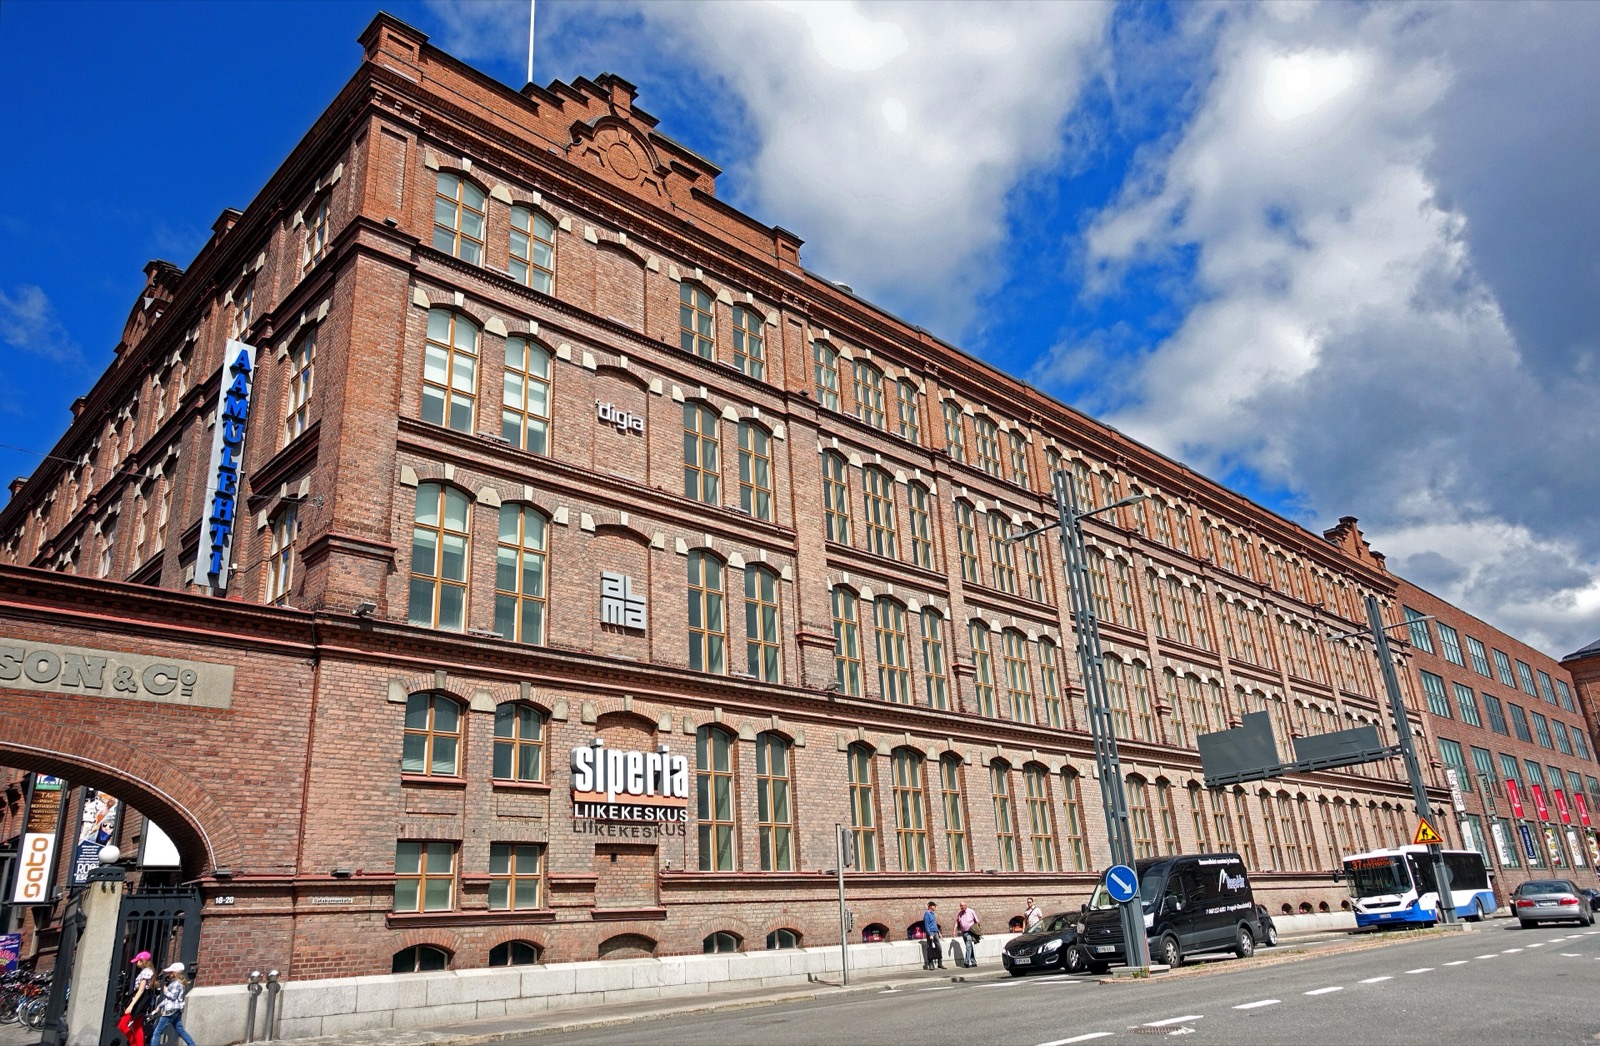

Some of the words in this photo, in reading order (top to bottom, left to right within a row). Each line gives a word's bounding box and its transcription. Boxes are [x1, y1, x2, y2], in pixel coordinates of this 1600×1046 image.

[598, 402, 644, 431] digia
[209, 348, 252, 575] AAMULEHTI
[113, 665, 138, 693] &
[571, 738, 689, 803] siperia
[574, 803, 689, 823] LIIKEKESKUS
[1351, 860, 1362, 870] 37
[215, 896, 234, 904] 18-20
